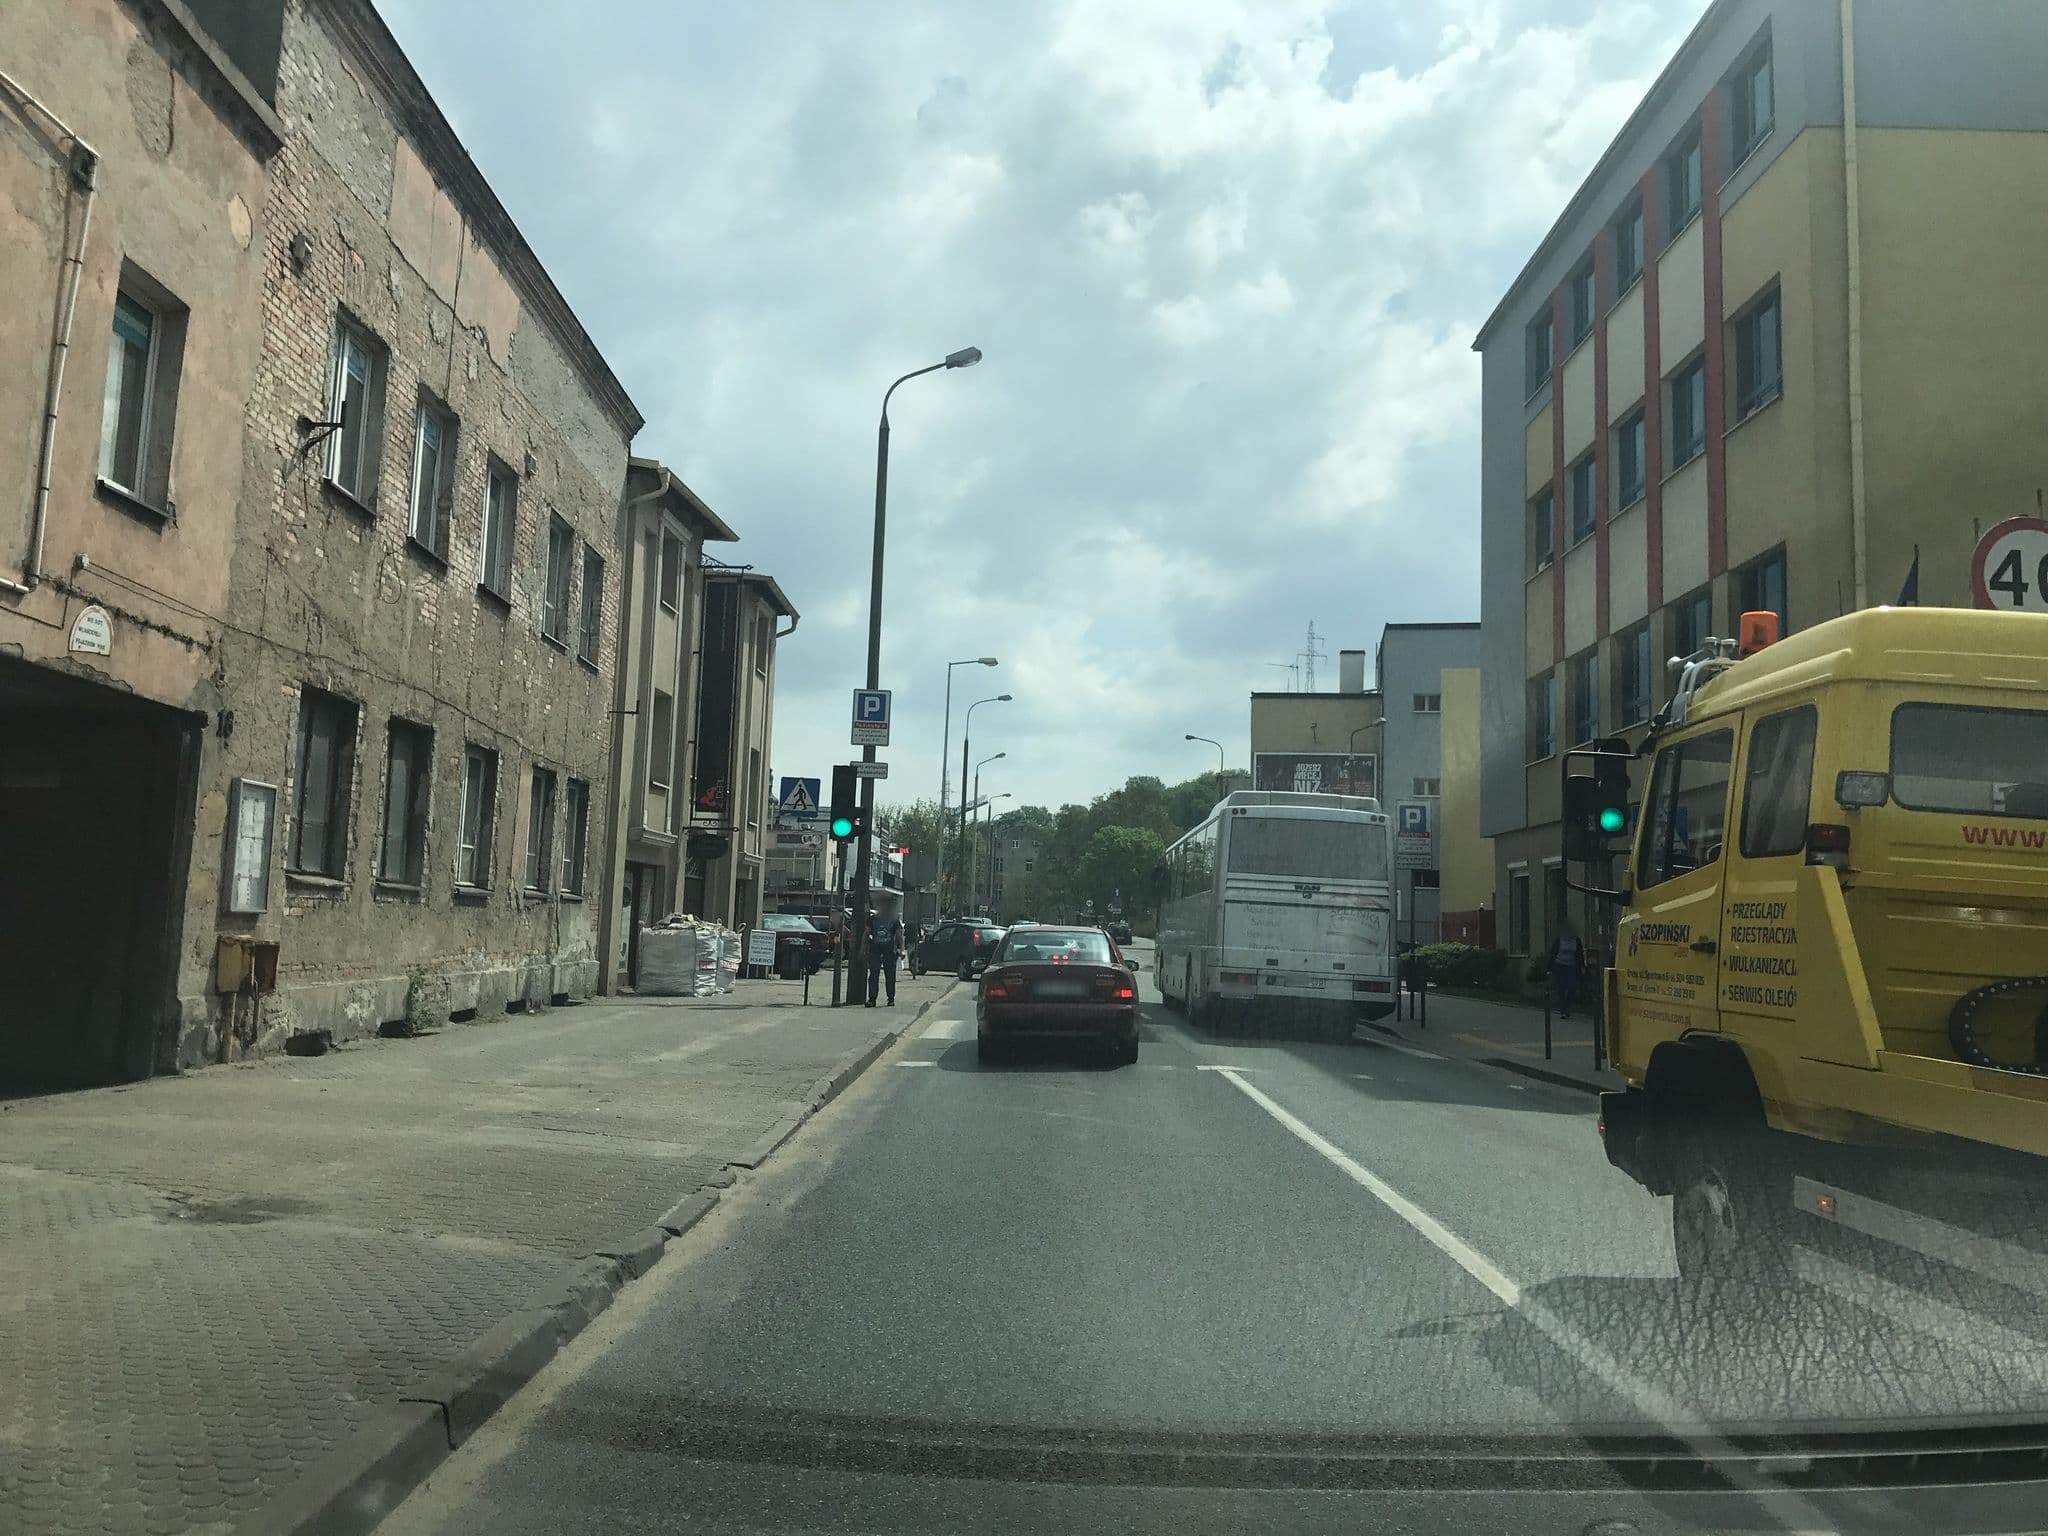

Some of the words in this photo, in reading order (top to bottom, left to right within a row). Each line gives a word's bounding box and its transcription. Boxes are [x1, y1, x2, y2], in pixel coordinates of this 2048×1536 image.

[1989, 549, 2048, 606] 4
[863, 696, 880, 718] P
[1405, 808, 1421, 829] P
[1732, 902, 1787, 923] PRZEGLĄDY
[1639, 920, 1690, 942] SZOPIŃSKI
[1728, 984, 1763, 1004] SERWIS
[1765, 985, 1797, 1008] OLEJÓ
